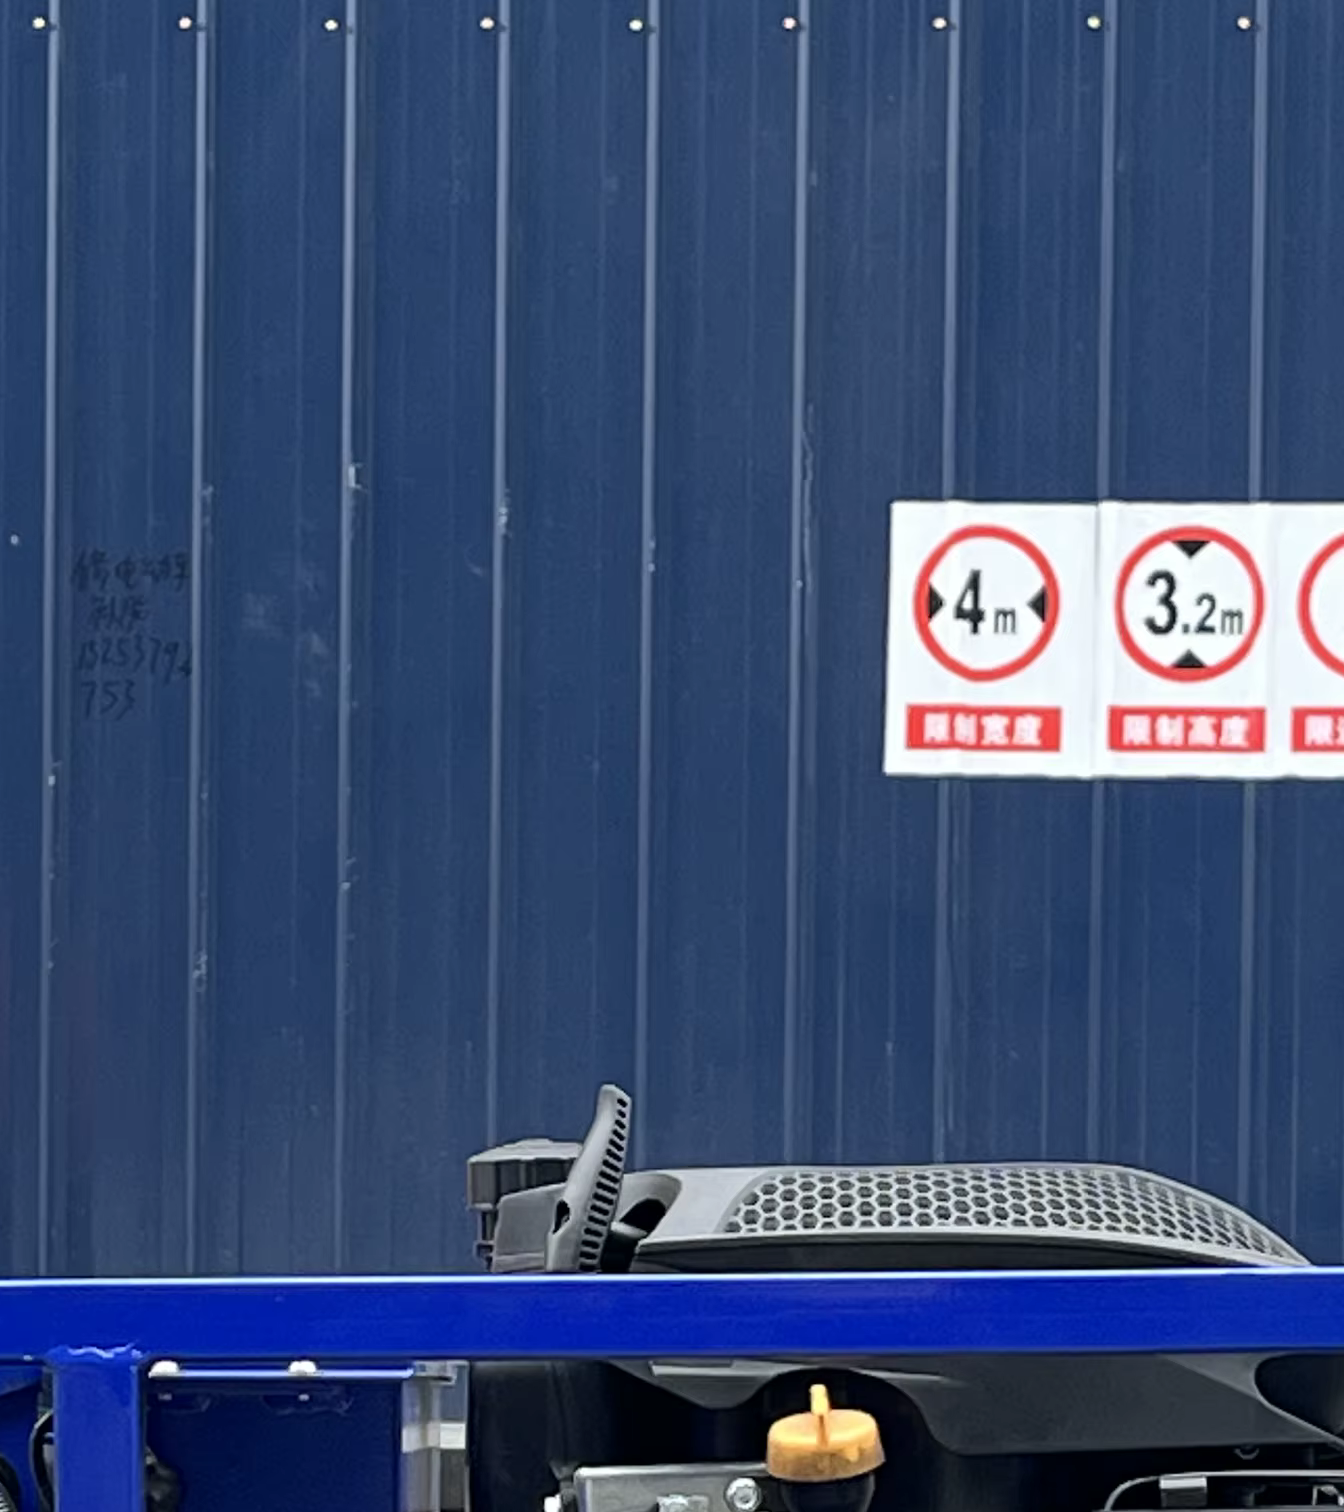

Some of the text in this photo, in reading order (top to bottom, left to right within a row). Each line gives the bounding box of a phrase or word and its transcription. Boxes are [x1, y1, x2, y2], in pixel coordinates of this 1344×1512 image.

[1144, 569, 1244, 635] 3.2m
[80, 679, 135, 720] 753
[922, 712, 1043, 746] 限制宽度
[1122, 713, 1250, 747] 限制高度
